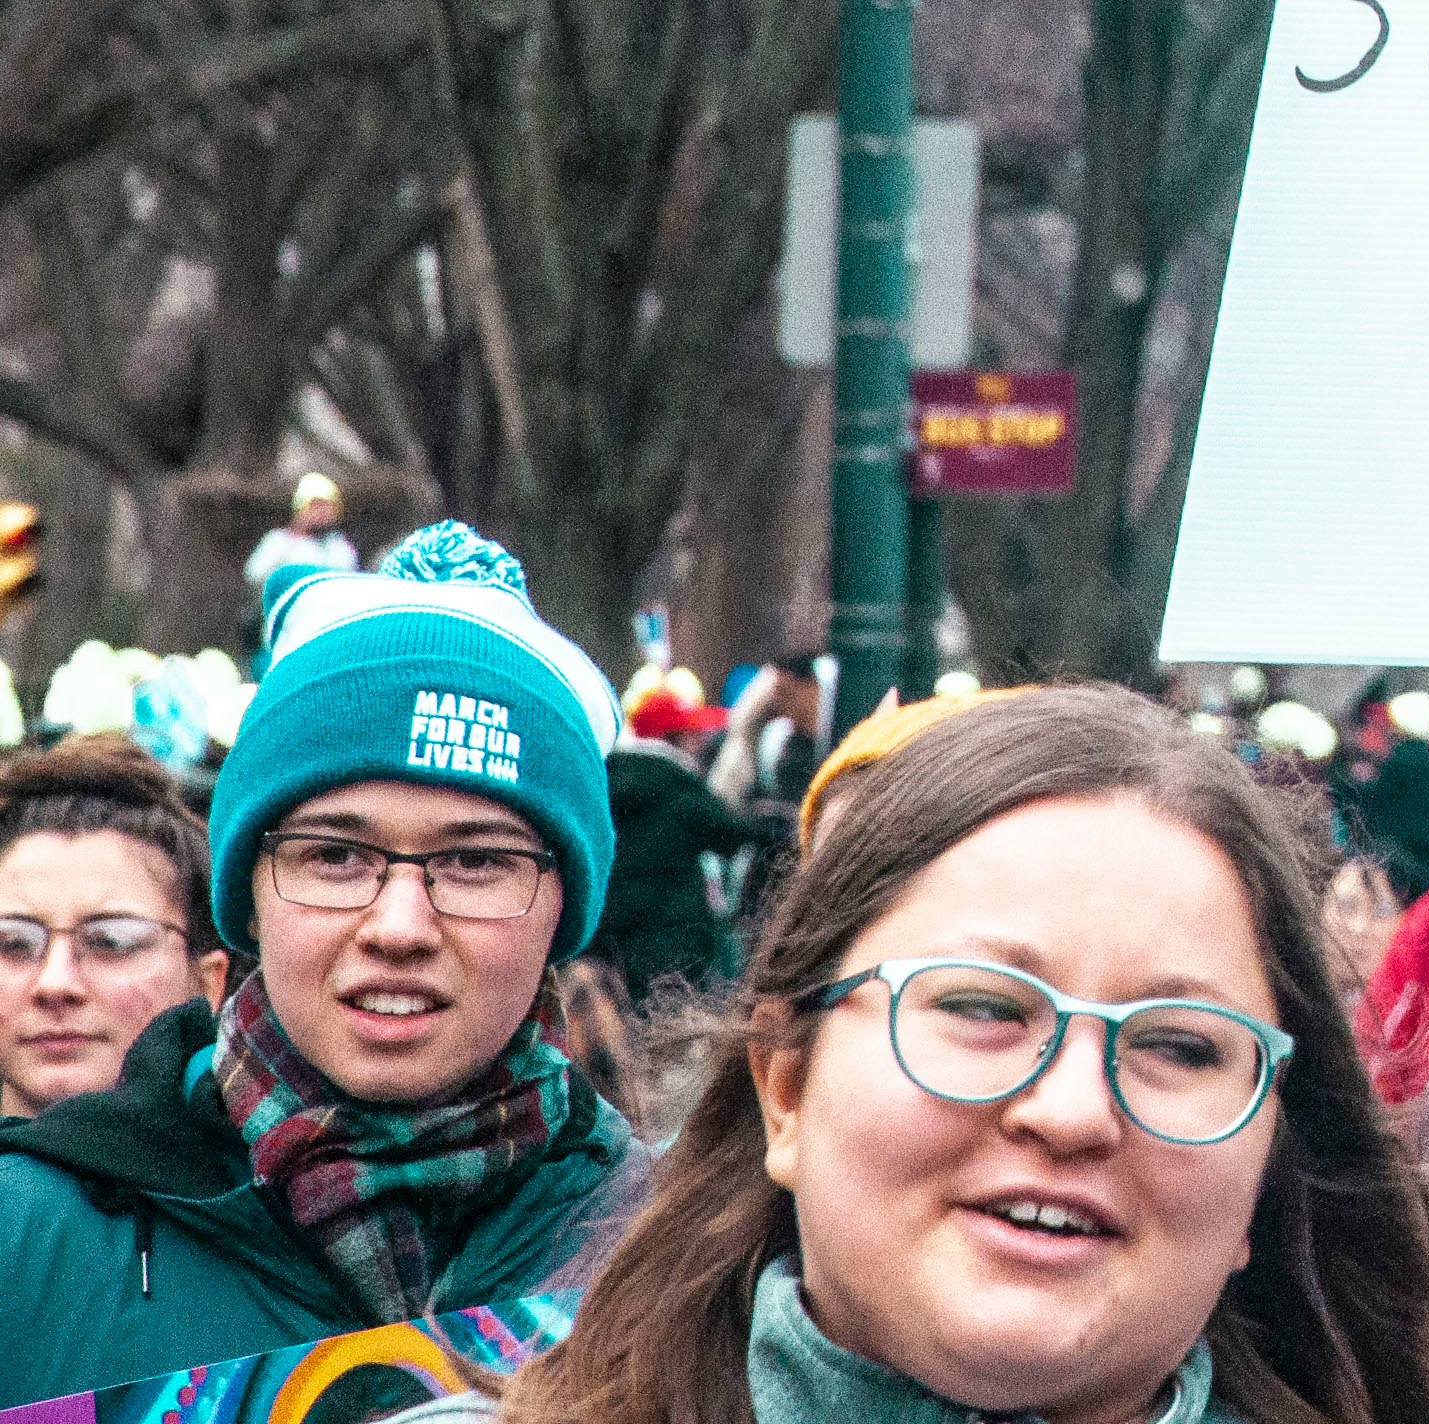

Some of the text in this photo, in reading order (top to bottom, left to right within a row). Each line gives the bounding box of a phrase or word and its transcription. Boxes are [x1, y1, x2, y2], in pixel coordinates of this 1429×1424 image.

[414, 690, 509, 729] MARCH
[411, 715, 521, 759] FOR OUR
[406, 741, 486, 774] LIVES
